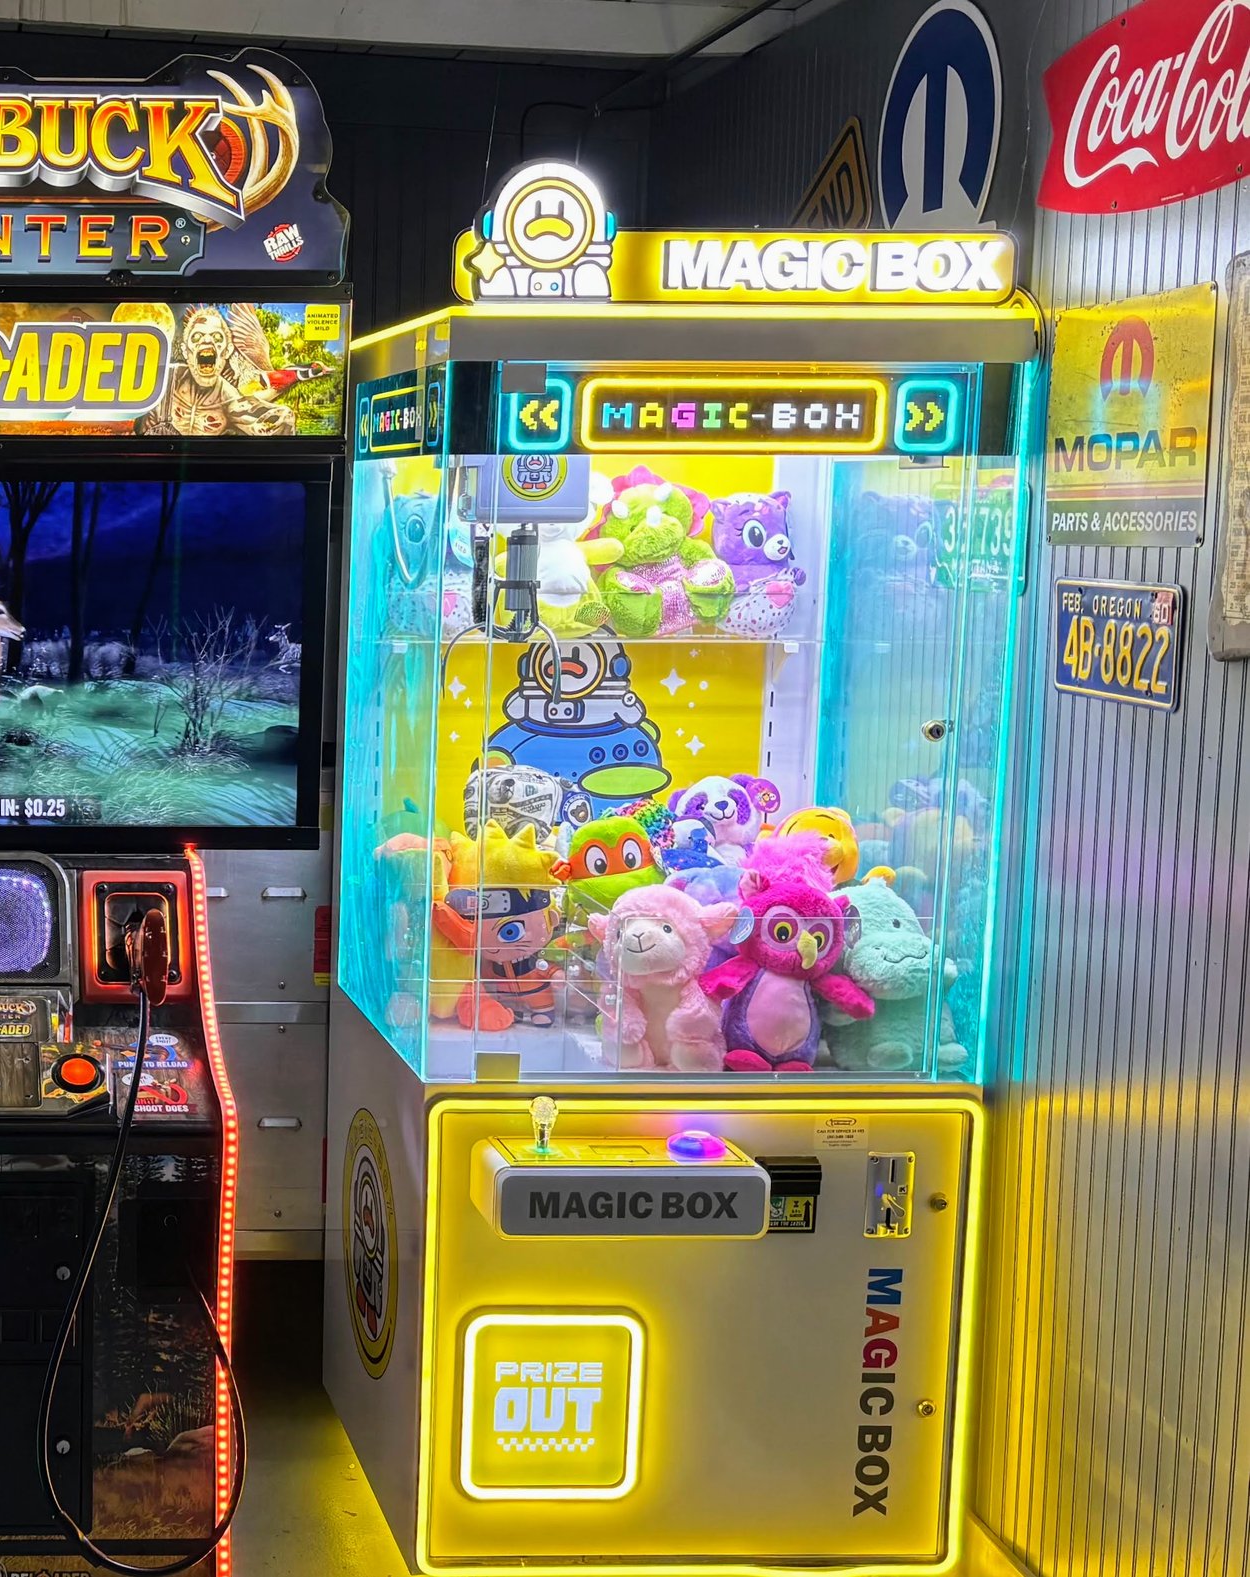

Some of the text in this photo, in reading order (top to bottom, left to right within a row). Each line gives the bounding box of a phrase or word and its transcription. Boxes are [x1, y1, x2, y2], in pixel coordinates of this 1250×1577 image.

[263, 224, 299, 253] RAW
[268, 236, 304, 260] THRILLS
[663, 239, 1004, 291] MAGIC BOX
[372, 405, 422, 433] MAGIC-BOX
[601, 402, 860, 429] MAGIC-BOX
[1054, 427, 1198, 472] MOPAR
[1051, 510, 1198, 531] PARTS & ACCESSORIES
[1062, 592, 1084, 614] FEB.
[1092, 595, 1143, 619] OREGON
[0, 799, 20, 816] IN:
[24, 798, 66, 818] $0.25
[134, 1104, 189, 1112] SHOOT DOES
[528, 1191, 739, 1219] MAGIC BOX
[494, 1361, 603, 1382] PRIZE
[852, 1268, 903, 1518] MAGIC BOX
[493, 1387, 603, 1433] OUT
